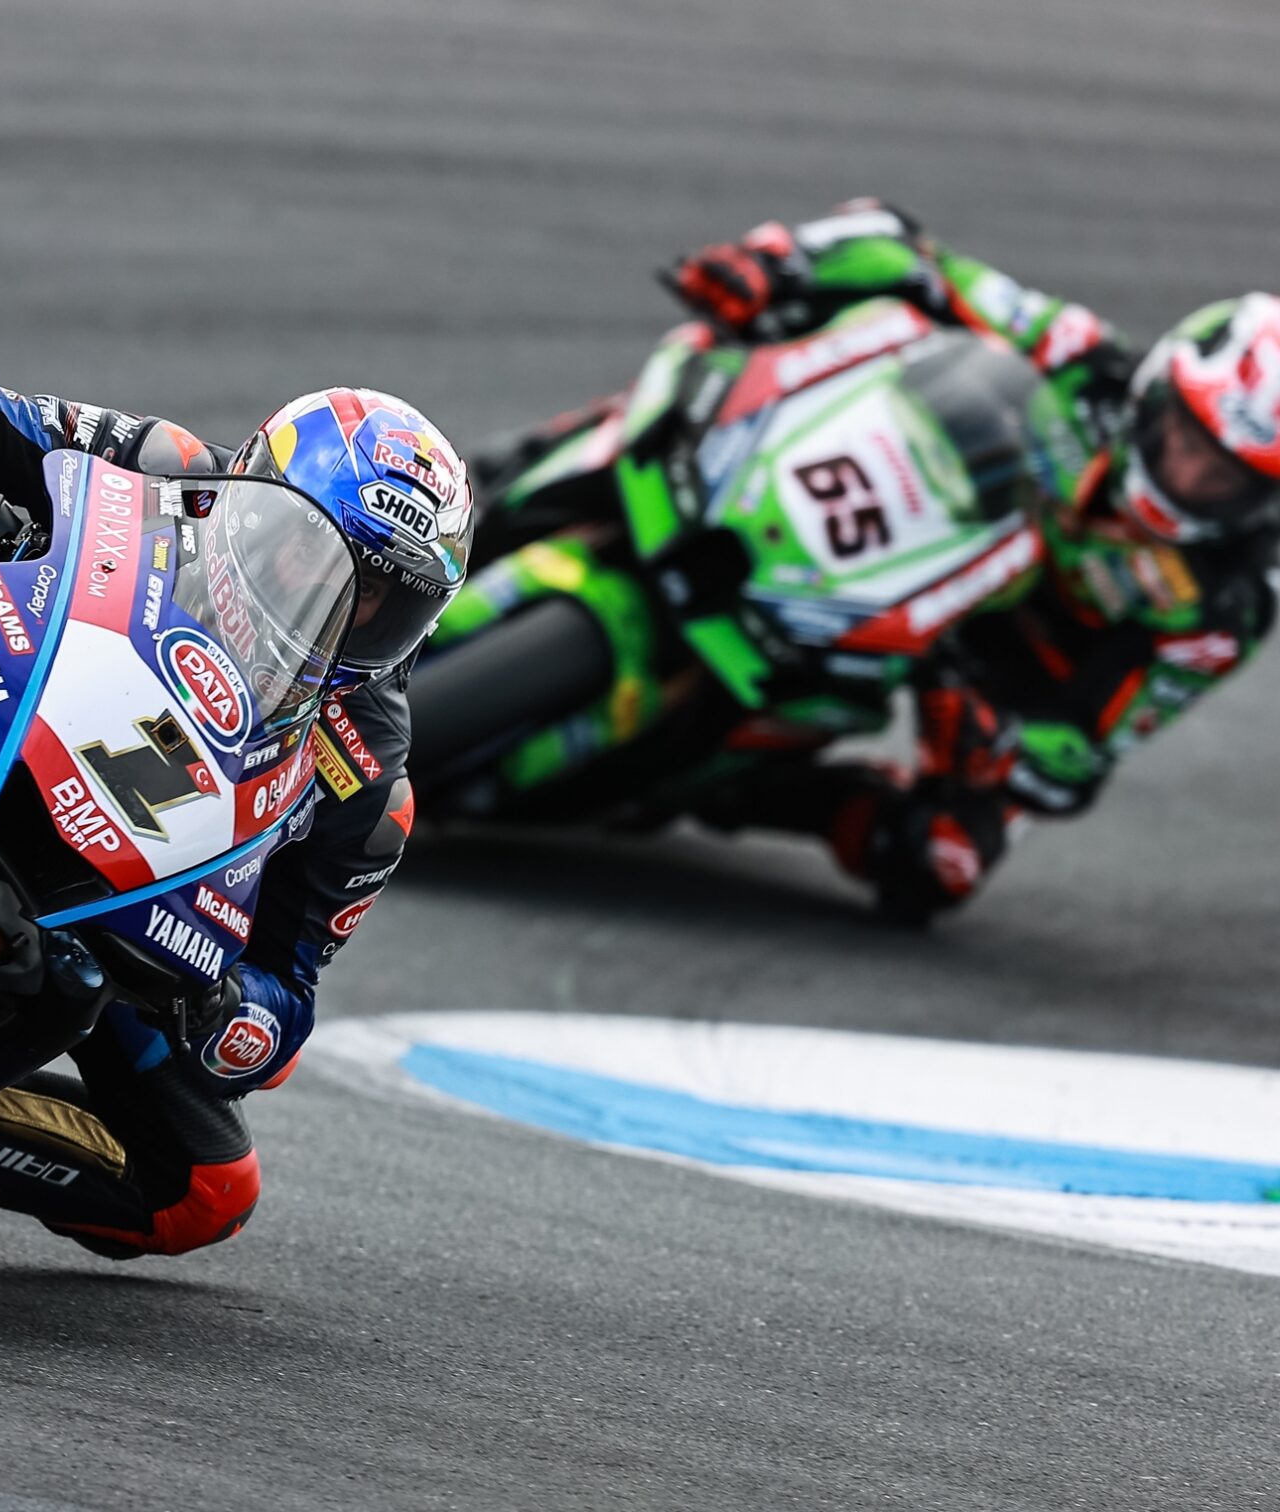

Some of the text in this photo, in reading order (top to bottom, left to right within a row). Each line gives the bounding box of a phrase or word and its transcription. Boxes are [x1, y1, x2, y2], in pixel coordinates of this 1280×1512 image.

[372, 442, 458, 506] Red Bull
[371, 487, 433, 538] SHOEI
[793, 453, 892, 561] 65
[87, 490, 133, 599] BRIXX.COM
[307, 511, 441, 599] GIVE YOU WINGS
[26, 564, 58, 618] Corpay
[142, 574, 164, 631] GYTR
[180, 650, 235, 724] PATA
[207, 646, 242, 695] SNACK
[243, 741, 281, 770] GYTR
[335, 717, 381, 778] BRIXX
[72, 715, 222, 844] 1
[50, 776, 120, 852] BMP
[51, 801, 91, 852] TAPPI
[225, 856, 262, 887] Corpay
[344, 862, 397, 890] DAIN
[196, 886, 251, 939] McAMS
[145, 904, 225, 981] YAMAHA
[224, 1026, 266, 1065] PATA
